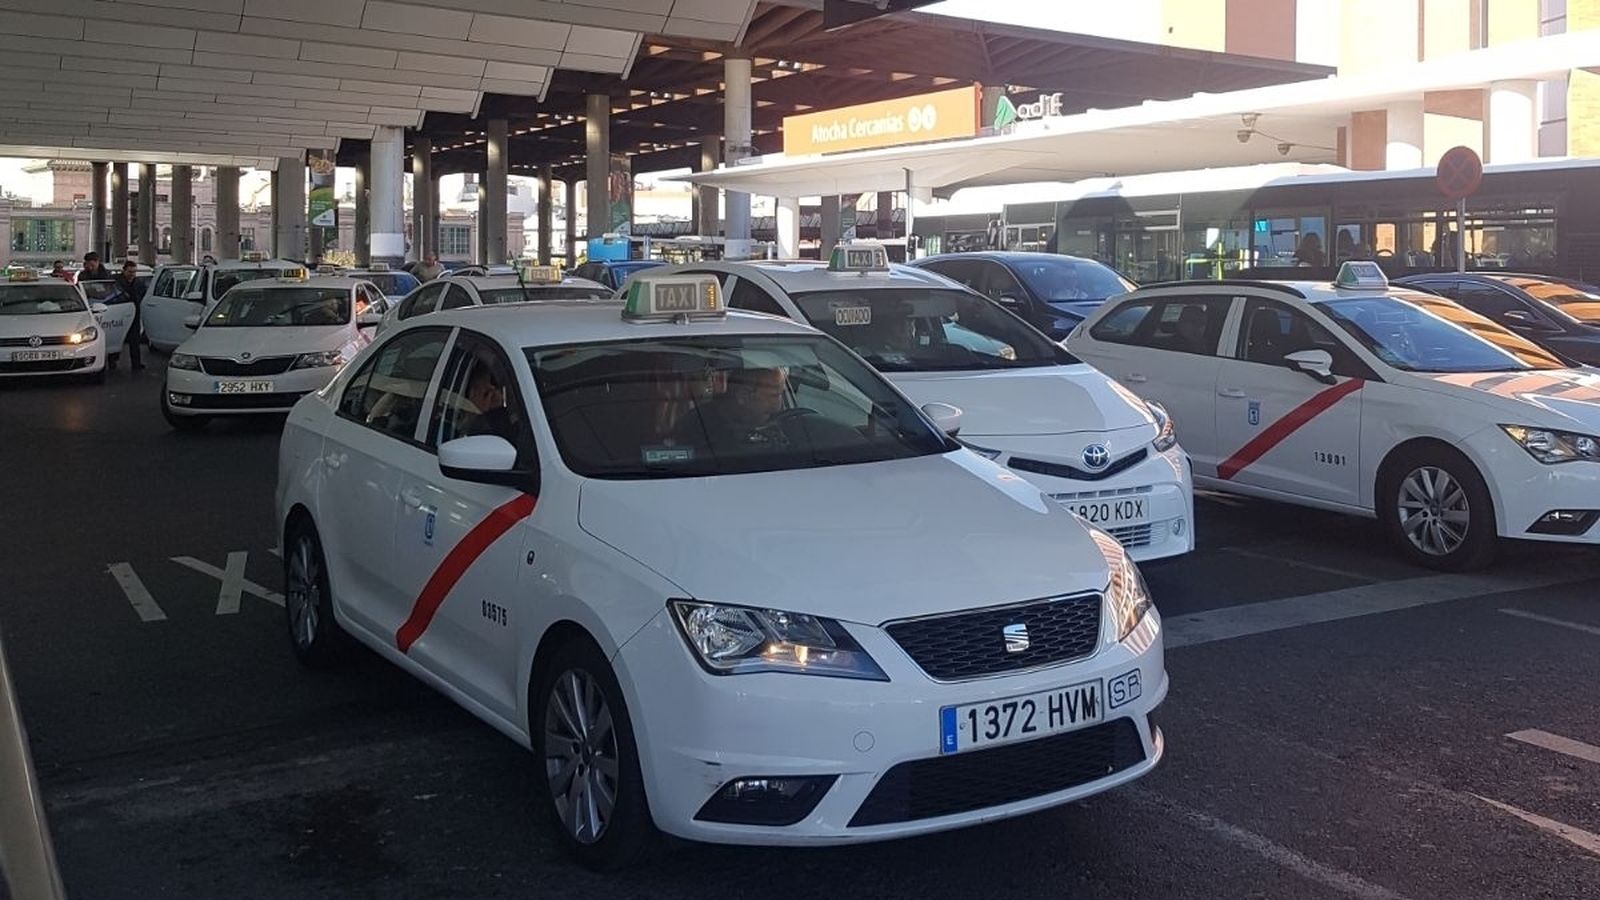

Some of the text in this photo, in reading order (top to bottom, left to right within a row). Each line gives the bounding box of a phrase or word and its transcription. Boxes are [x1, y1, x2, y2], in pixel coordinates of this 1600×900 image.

[1017, 93, 1064, 118] adif
[811, 122, 848, 144] Atocha
[849, 252, 871, 267] TAXI
[657, 287, 696, 308] TAXI
[221, 382, 246, 393] 2952
[1115, 500, 1143, 521] KDX
[968, 700, 1037, 743] 1372
[1049, 686, 1096, 728] HVM
